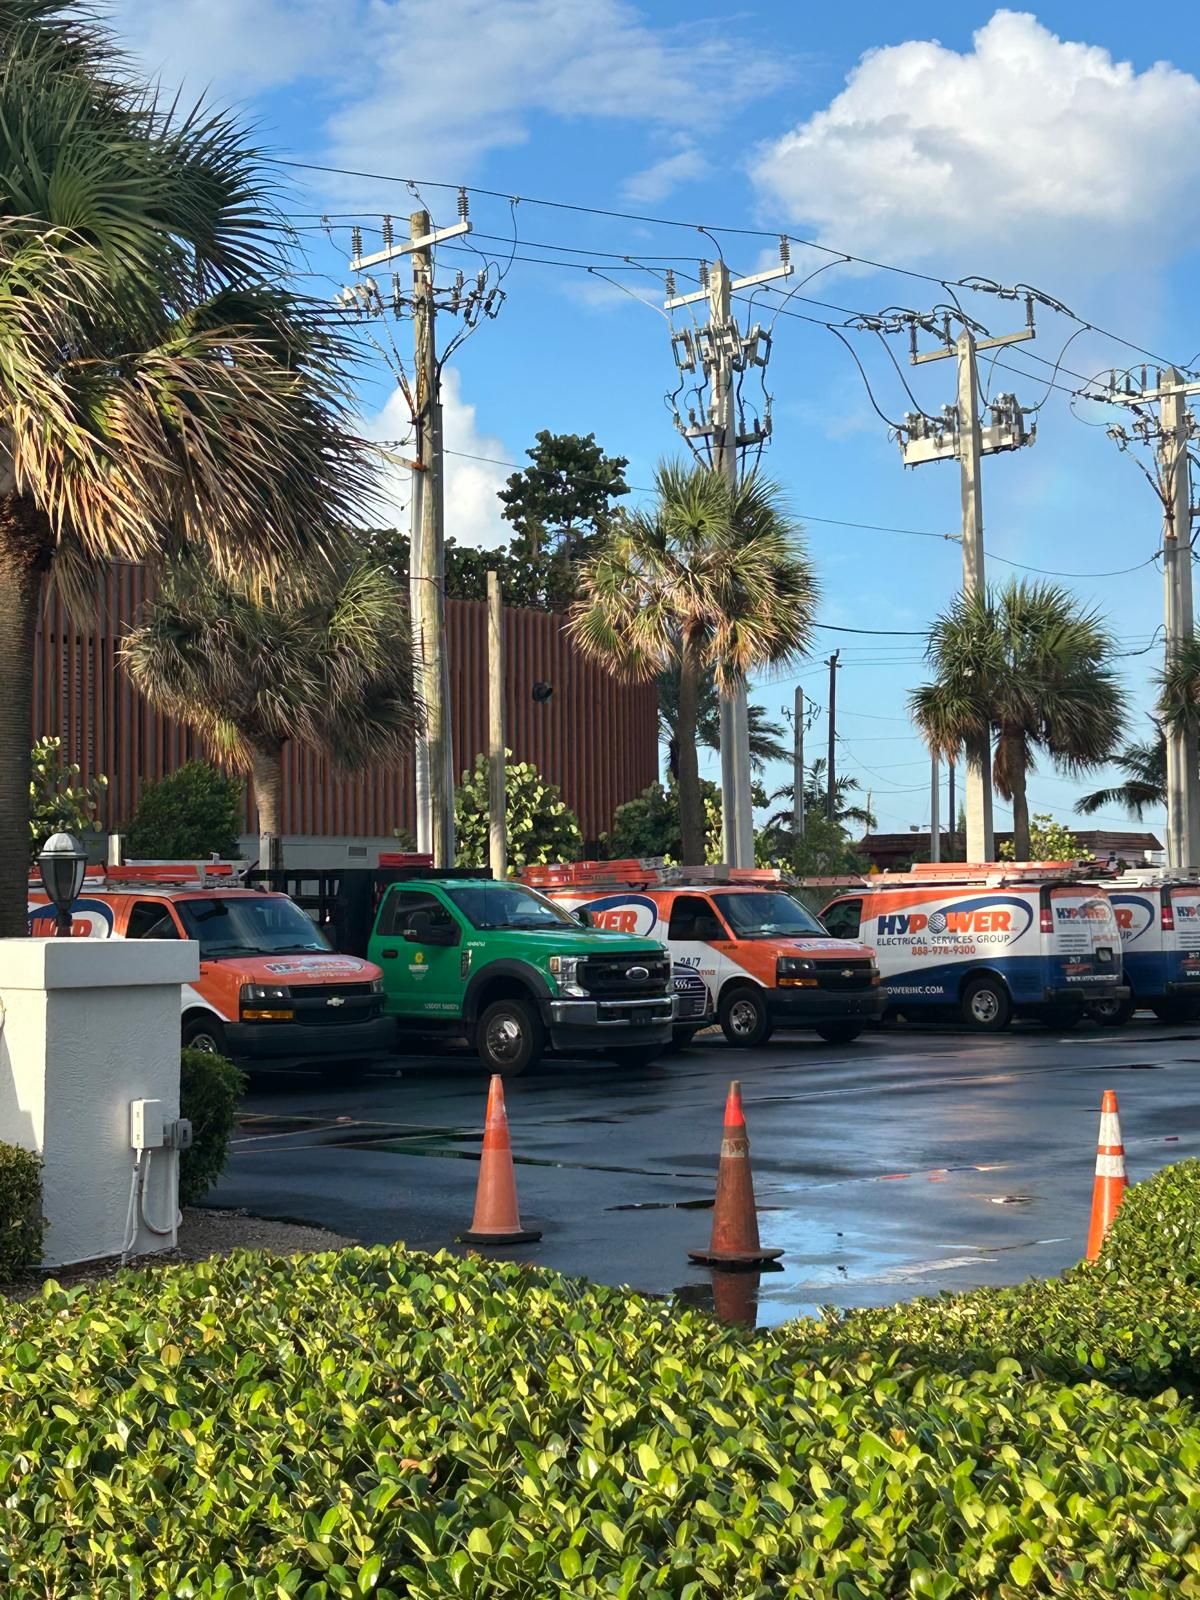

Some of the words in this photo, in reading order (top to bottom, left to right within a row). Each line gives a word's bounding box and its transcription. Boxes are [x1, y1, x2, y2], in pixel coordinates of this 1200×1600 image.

[877, 911, 1011, 935] HYPOWER
[876, 936, 928, 947] ELECTRICAL
[931, 935, 974, 945] SERVICES
[976, 934, 1010, 944] GROUP
